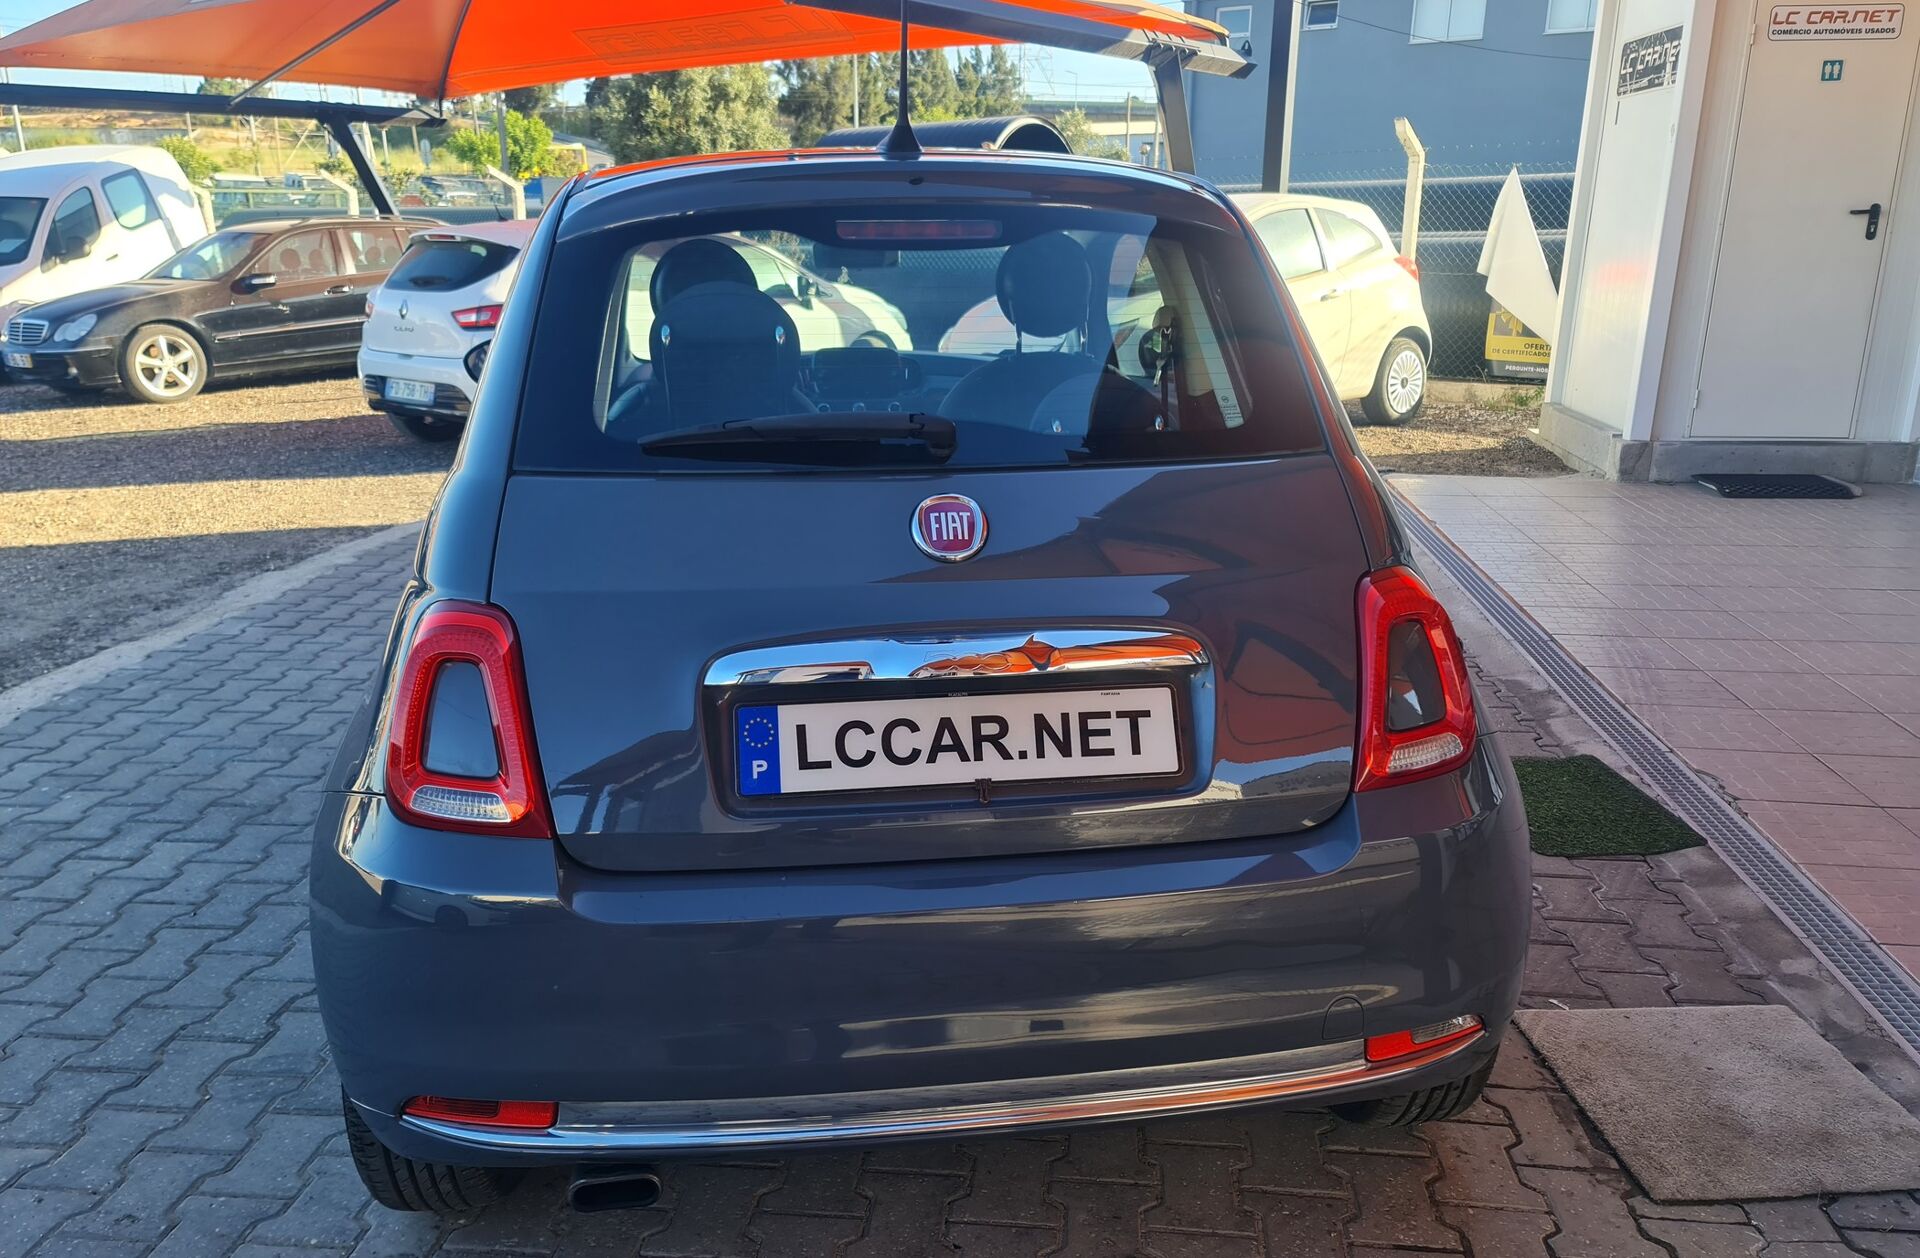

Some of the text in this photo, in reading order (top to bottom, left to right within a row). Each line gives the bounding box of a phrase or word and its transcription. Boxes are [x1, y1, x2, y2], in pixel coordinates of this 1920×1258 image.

[1772, 9, 1902, 25] LC CAR.NET
[1772, 28, 1812, 36] COMÉRCIO
[1813, 26, 1863, 35] AUTOMÓVEIS
[929, 511, 970, 541] FIAT
[752, 710, 1152, 779] P LCCAR.NET
